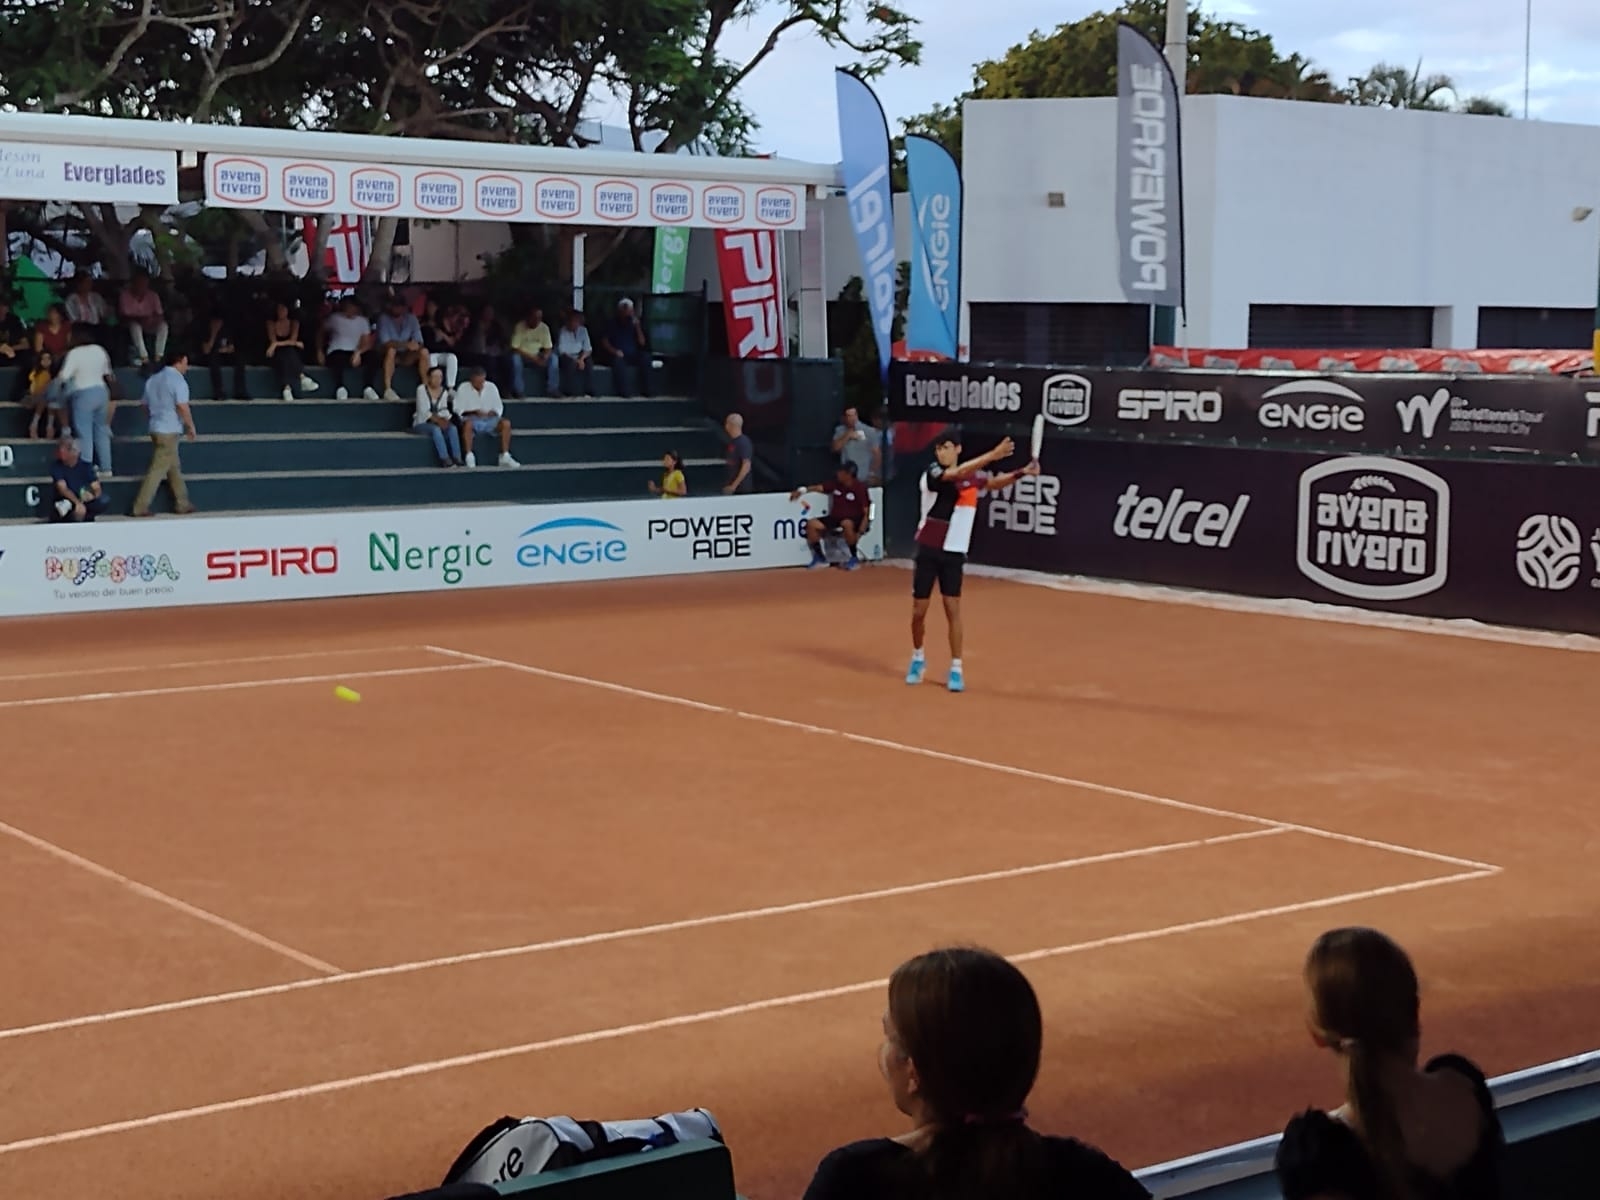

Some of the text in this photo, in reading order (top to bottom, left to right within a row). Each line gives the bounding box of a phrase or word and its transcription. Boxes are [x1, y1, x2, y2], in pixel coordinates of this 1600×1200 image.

[64, 161, 167, 187] Everglades
[220, 168, 261, 184] avena
[289, 174, 329, 188] avena
[357, 178, 394, 192] avena
[220, 181, 261, 195] rivero
[289, 186, 329, 199] rivero
[420, 182, 457, 194] avena
[481, 185, 517, 196] avena
[541, 188, 575, 199] avena
[357, 190, 394, 202] rivero
[420, 193, 457, 206] rivero
[481, 195, 517, 208] rivero
[600, 191, 633, 202] avena
[656, 193, 688, 204] avena
[708, 196, 739, 206] avena
[541, 198, 575, 210] rivero
[600, 201, 633, 213] rivero
[656, 203, 688, 215] rivero
[761, 198, 791, 208] avena
[708, 205, 739, 216] rivero
[761, 207, 791, 218] rivero
[905, 374, 1022, 411] Everglades
[1117, 388, 1222, 422] SPIRO
[0, 446, 13, 467] D
[25, 486, 40, 507] C
[989, 502, 1058, 536] ADE
[1113, 484, 1250, 548] telcel
[1317, 491, 1428, 534] avena
[648, 515, 753, 541] POWER
[693, 538, 752, 561] ADE
[1317, 530, 1426, 575] rivero
[206, 545, 338, 581] SPIRO
[369, 530, 492, 584] Nergic
[119, 587, 142, 597] buen
[145, 586, 174, 596] precio
